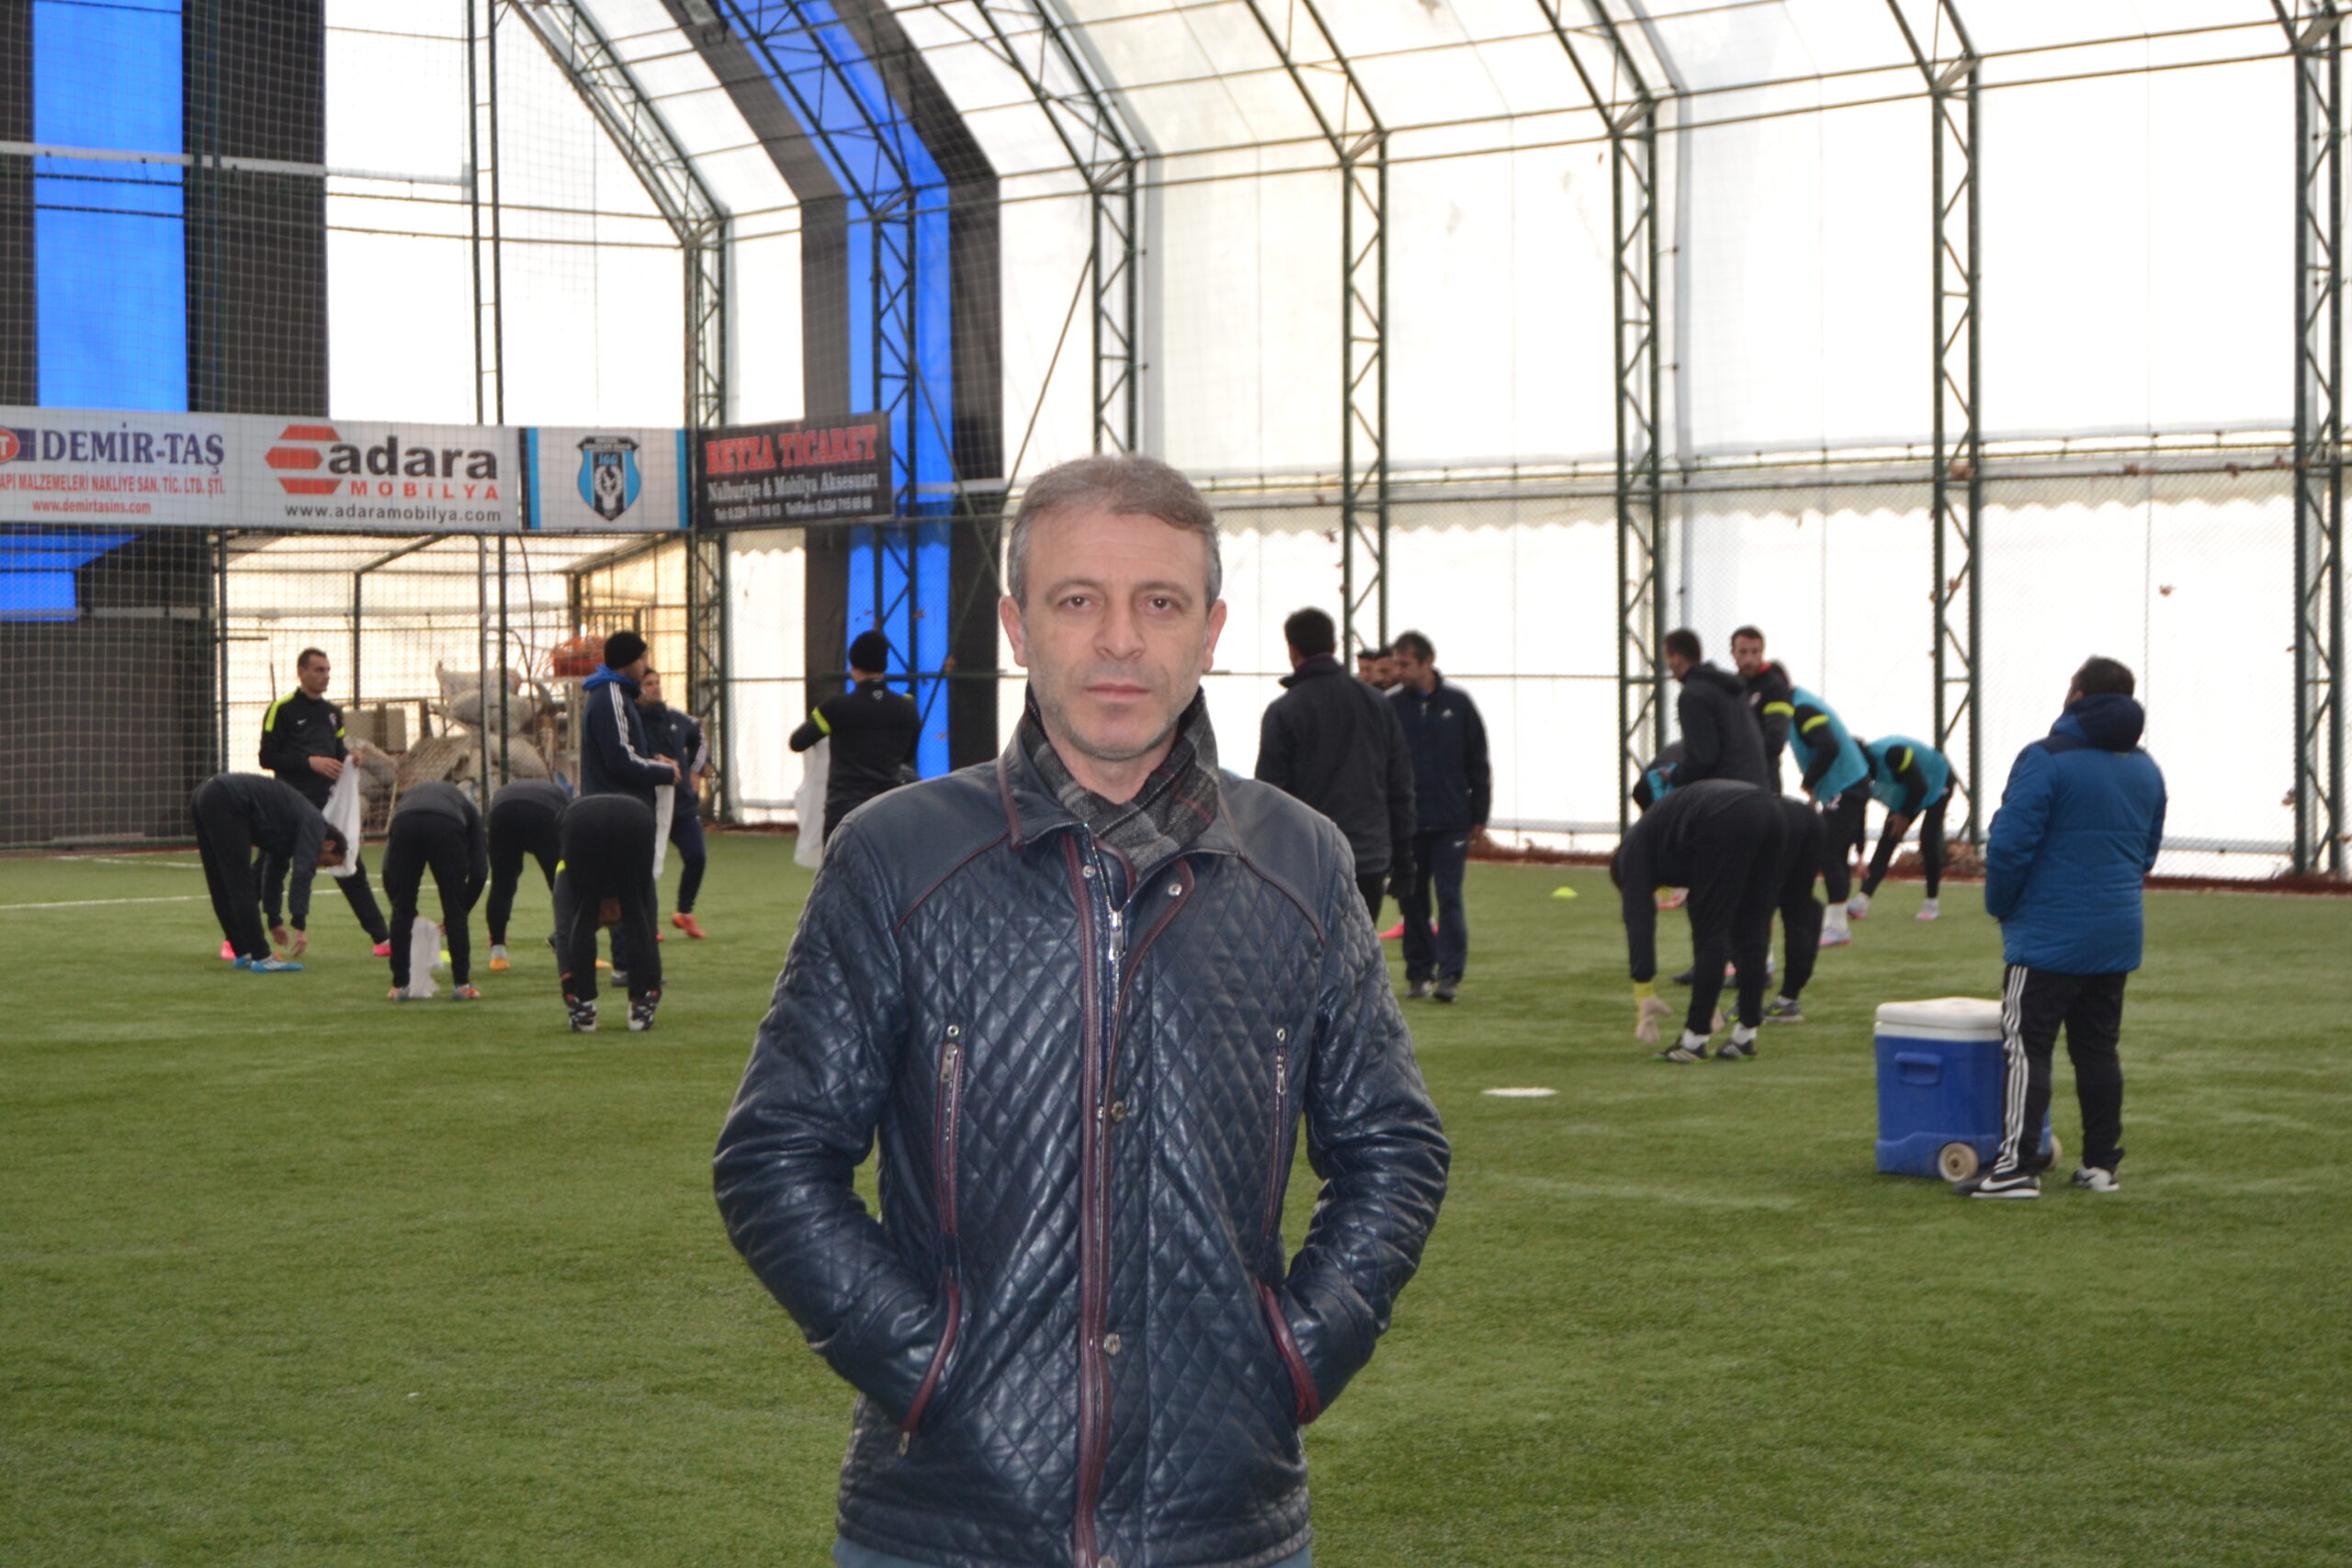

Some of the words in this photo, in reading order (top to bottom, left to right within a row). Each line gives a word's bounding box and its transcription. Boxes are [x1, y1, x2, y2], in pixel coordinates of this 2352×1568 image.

[41, 422, 225, 475] DEMİR-TAŞ
[328, 435, 498, 479] adara
[706, 435, 776, 474] BEYZA
[778, 422, 877, 468] TİCARET
[18, 471, 89, 491] MALZEMELERİ
[91, 473, 134, 492] NAKLİYE
[137, 477, 160, 493] SAN.
[32, 499, 152, 514] www.demirtasins.com
[285, 504, 502, 524] www.adaramobilya.com
